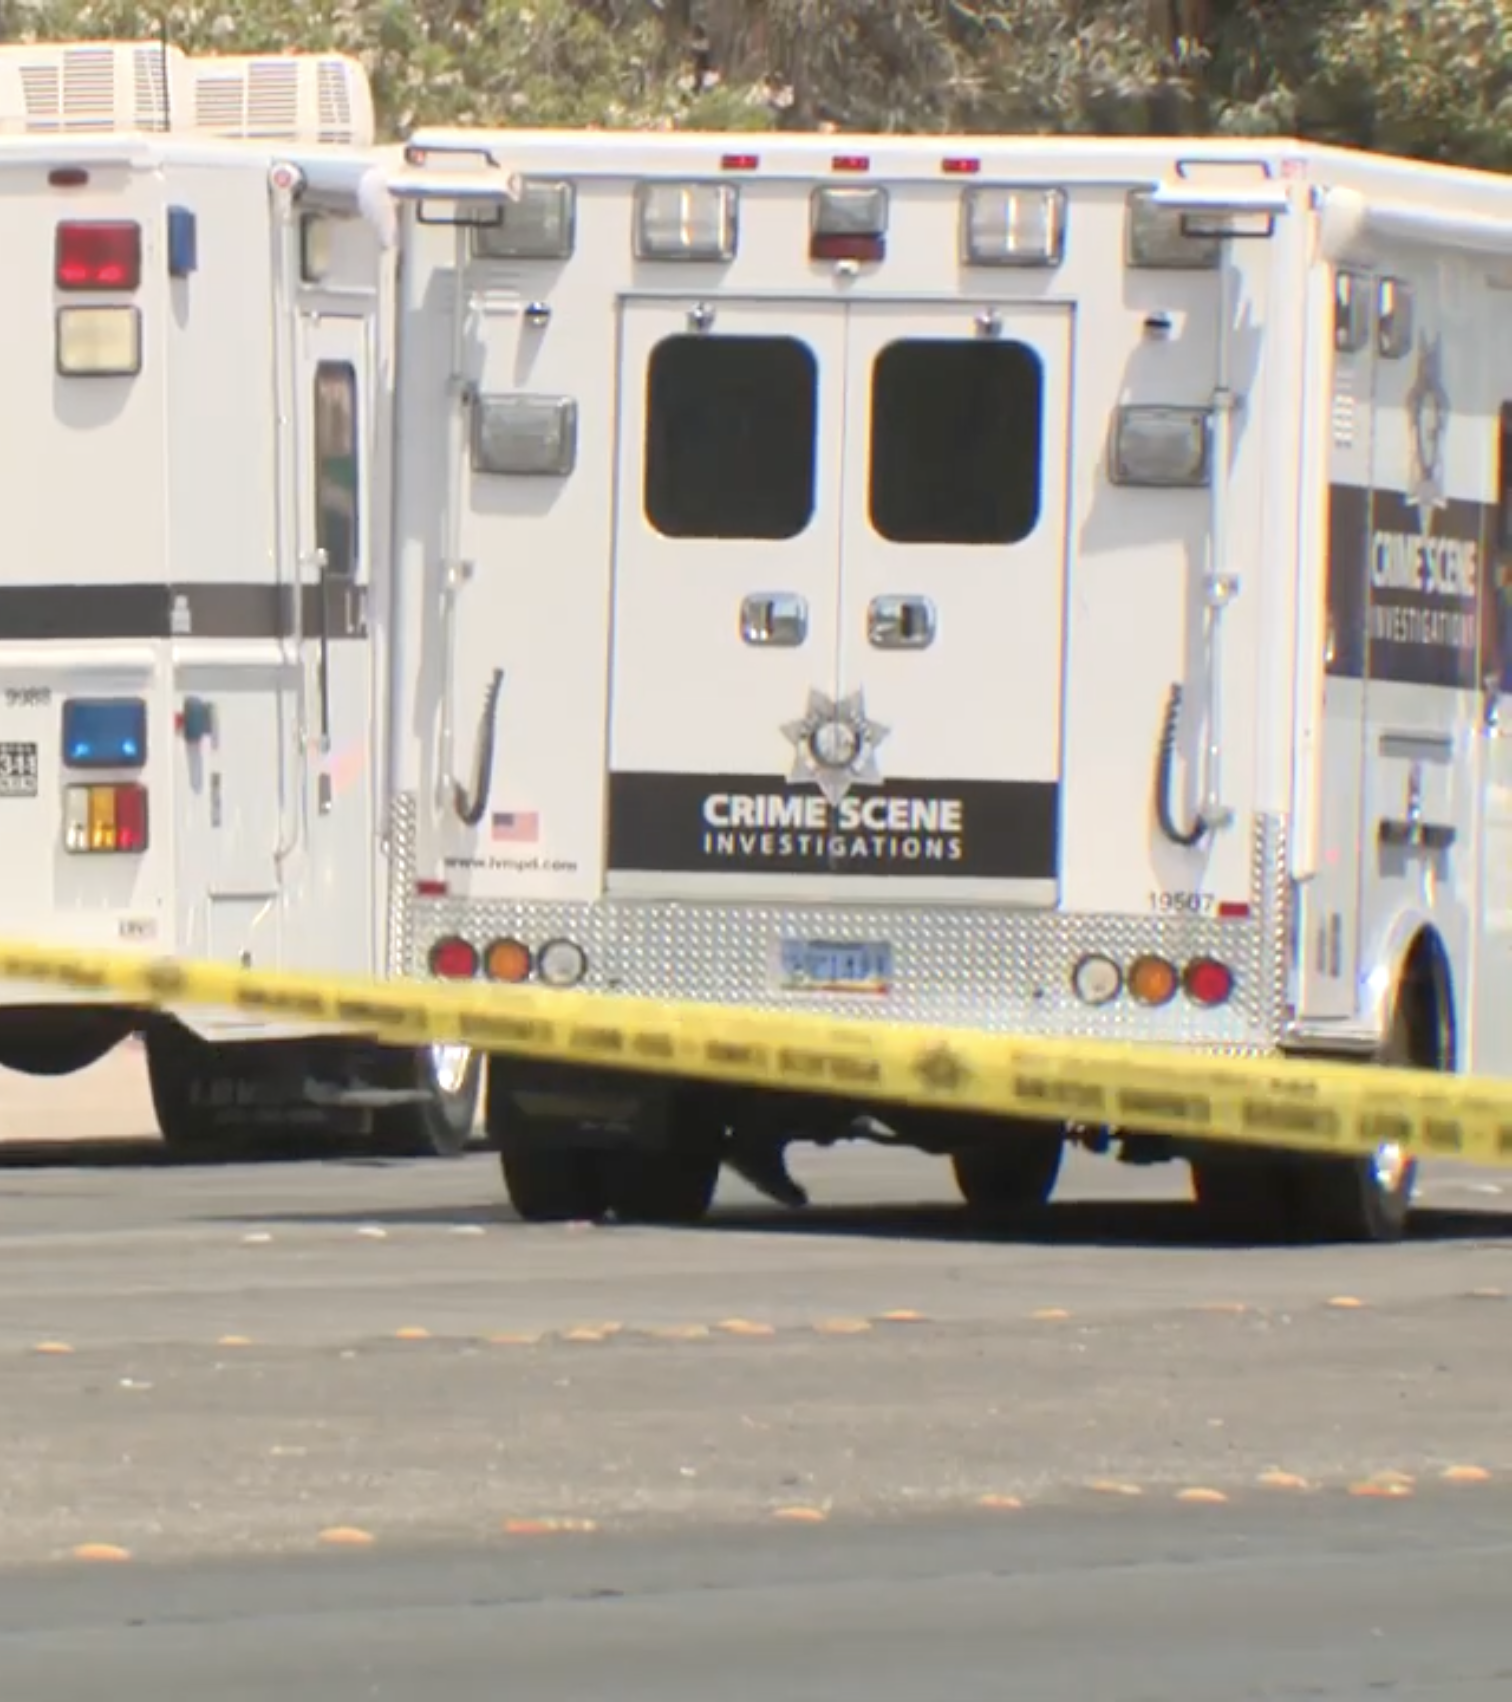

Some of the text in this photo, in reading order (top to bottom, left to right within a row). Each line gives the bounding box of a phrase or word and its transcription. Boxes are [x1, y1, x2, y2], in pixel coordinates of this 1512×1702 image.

[1373, 531, 1476, 596] CRIME SCENE
[703, 793, 963, 832] CRIME SCENE
[703, 831, 963, 860] INVESTIGATIONS
